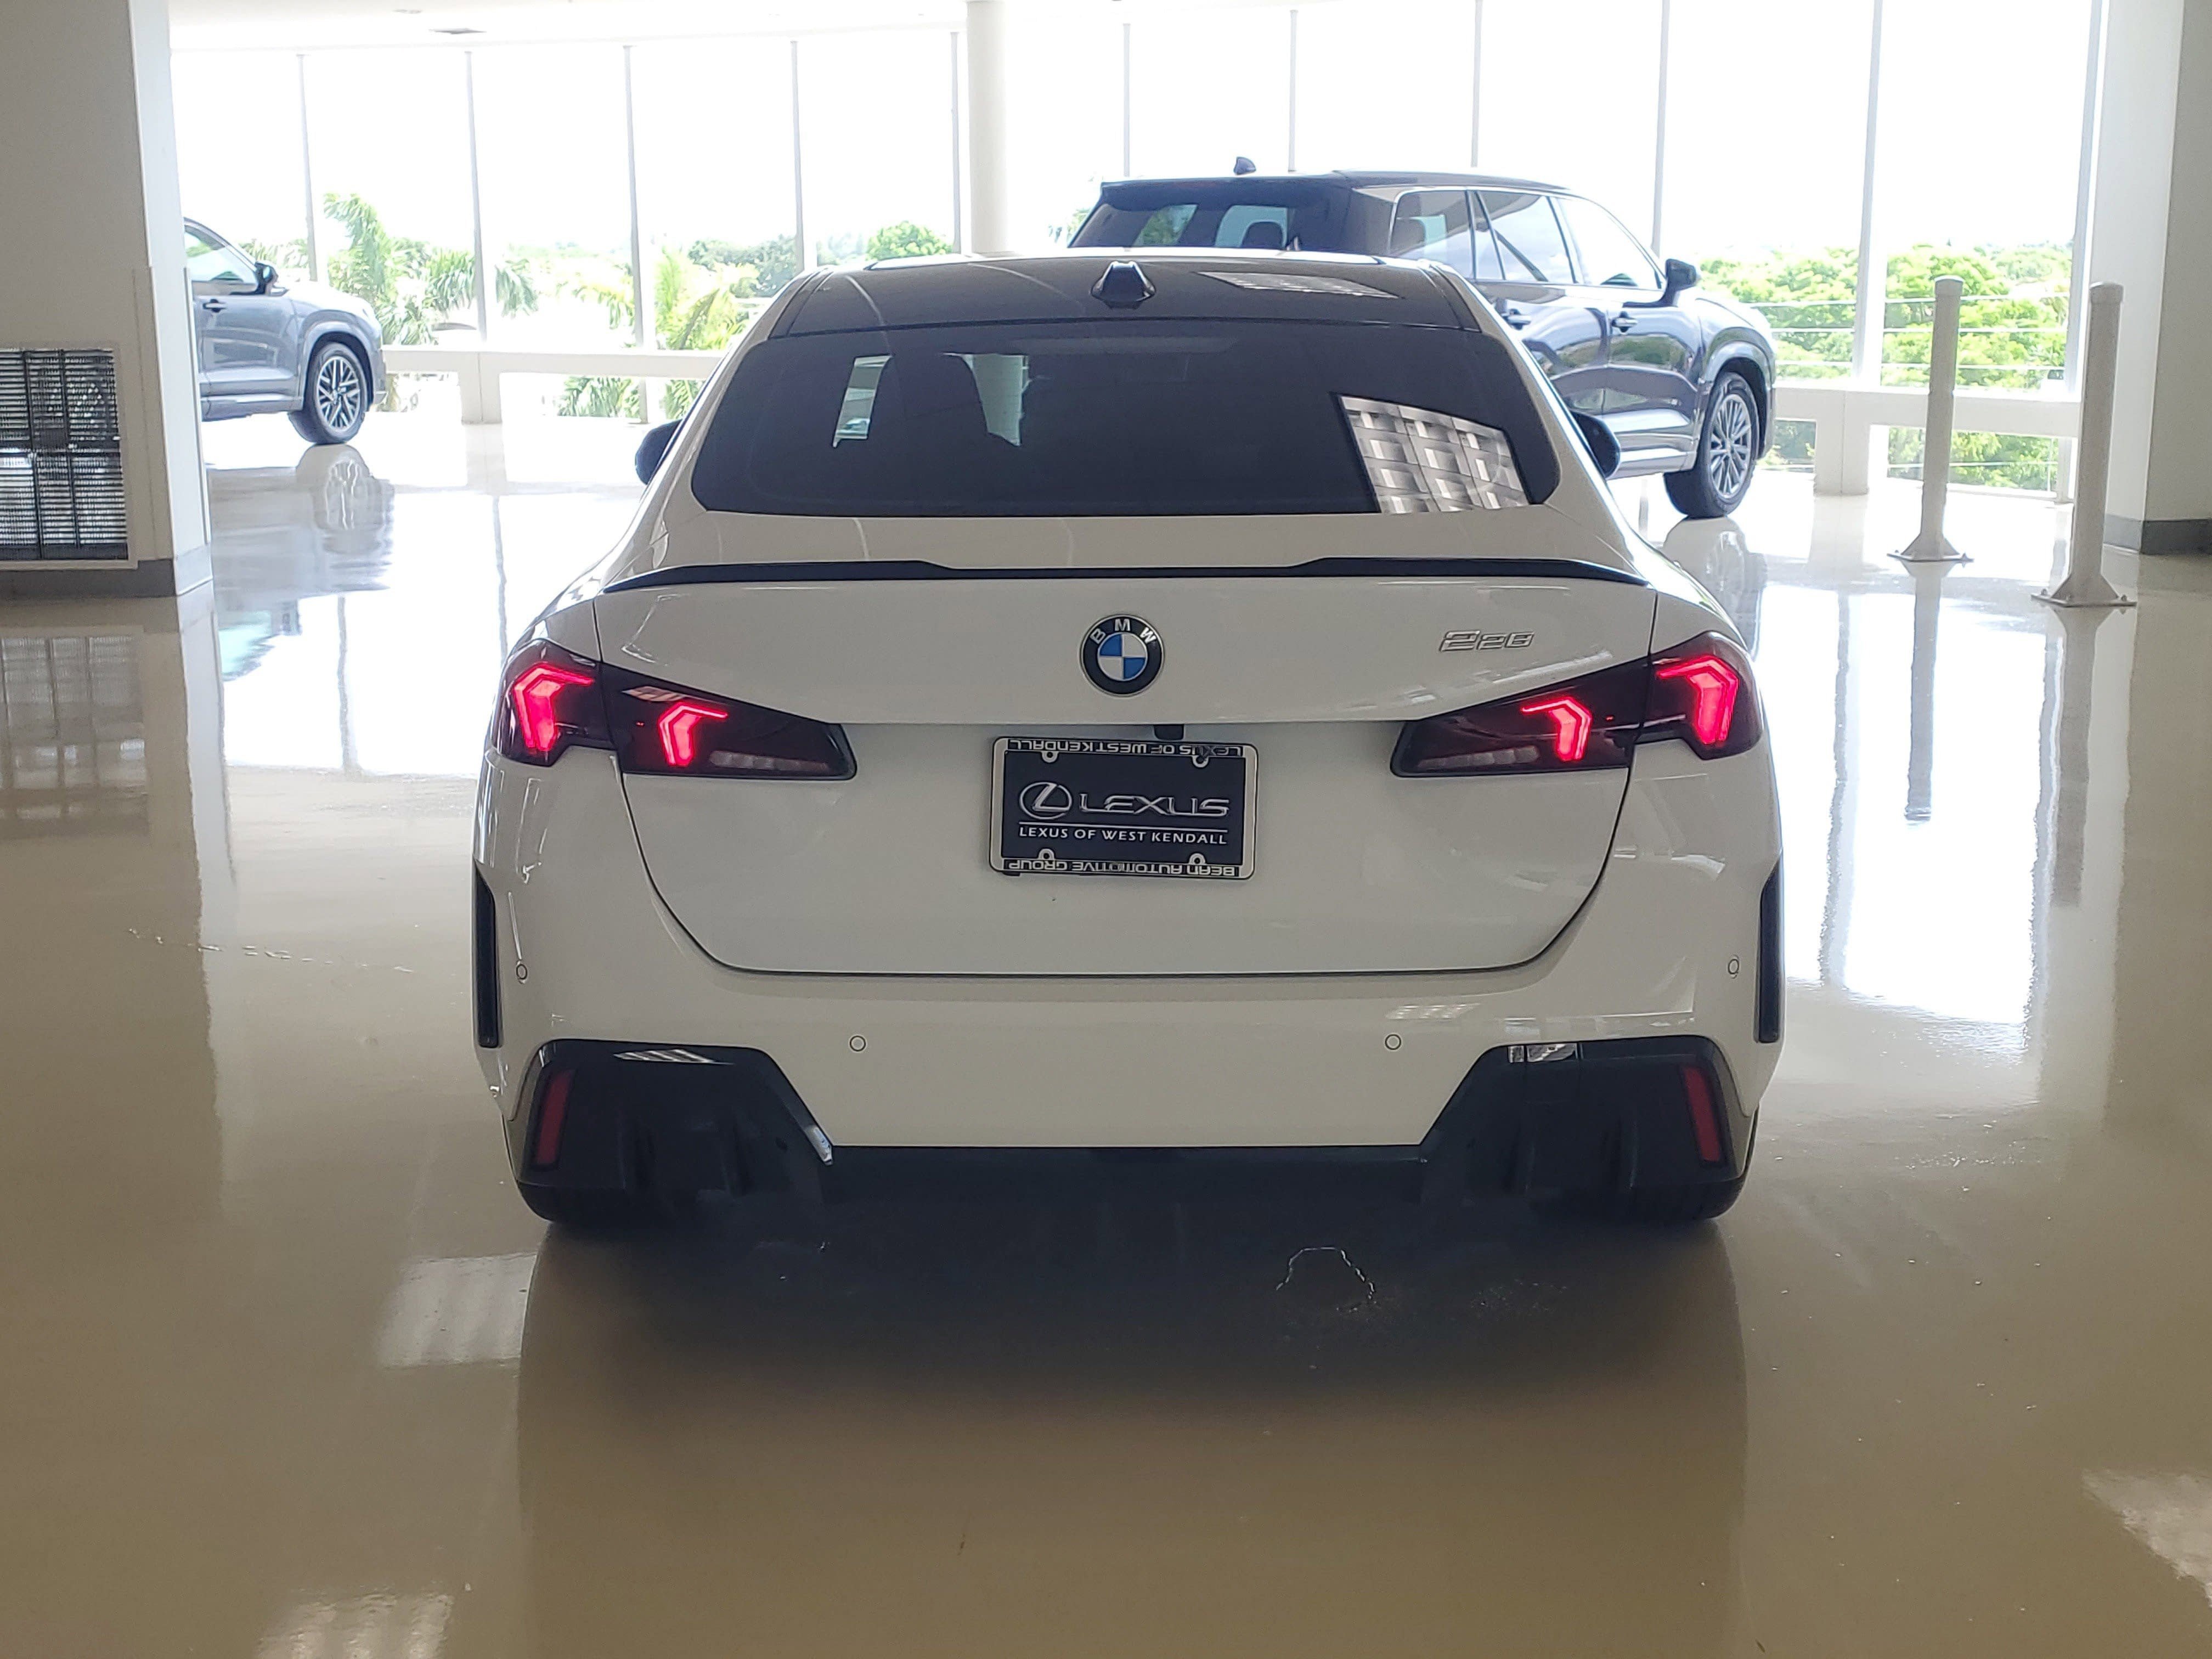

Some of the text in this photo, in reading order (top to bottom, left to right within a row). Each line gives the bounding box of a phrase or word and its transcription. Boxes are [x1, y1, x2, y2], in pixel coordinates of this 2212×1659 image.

[1090, 618, 1156, 644] BMW
[1009, 740, 1093, 752] KENDALL
[1096, 742, 1147, 754] WEST
[1151, 744, 1175, 755] OF
[1079, 793, 1229, 817] LEXUS
[1019, 827, 1227, 844] LEXUS OF WEST KENDALL
[1008, 859, 1235, 876] BEAN AUTOMOTIVE GROUP
